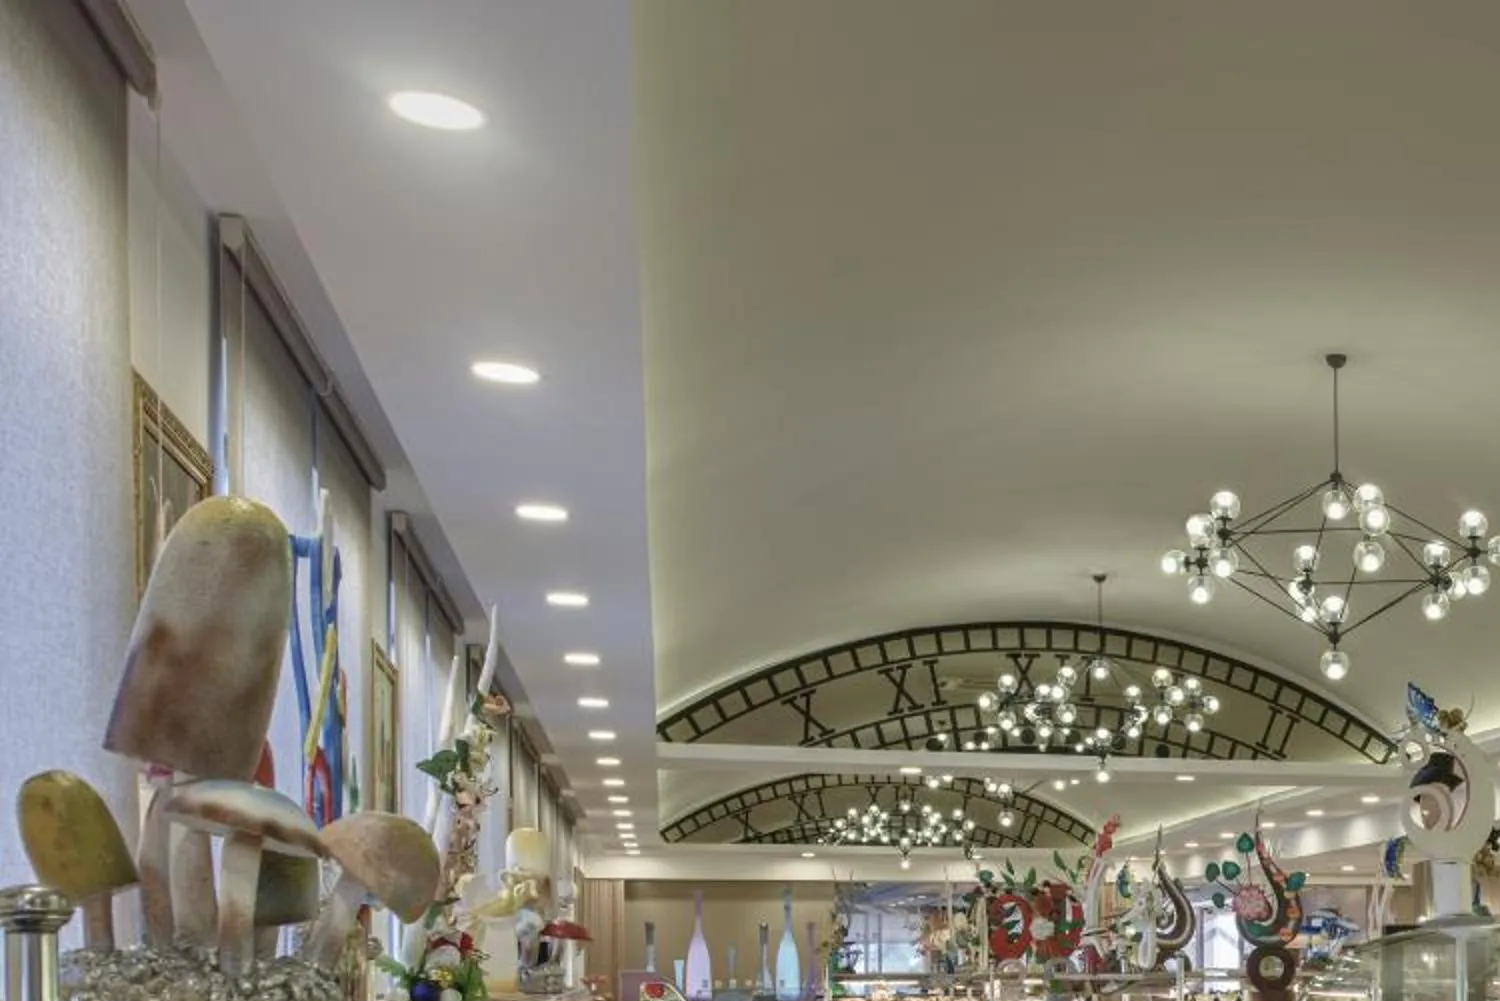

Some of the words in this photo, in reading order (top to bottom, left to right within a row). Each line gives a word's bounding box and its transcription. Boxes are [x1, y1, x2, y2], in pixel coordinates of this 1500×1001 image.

[781, 688, 836, 746] X
[877, 659, 948, 716] XI
[1255, 705, 1302, 758] II
